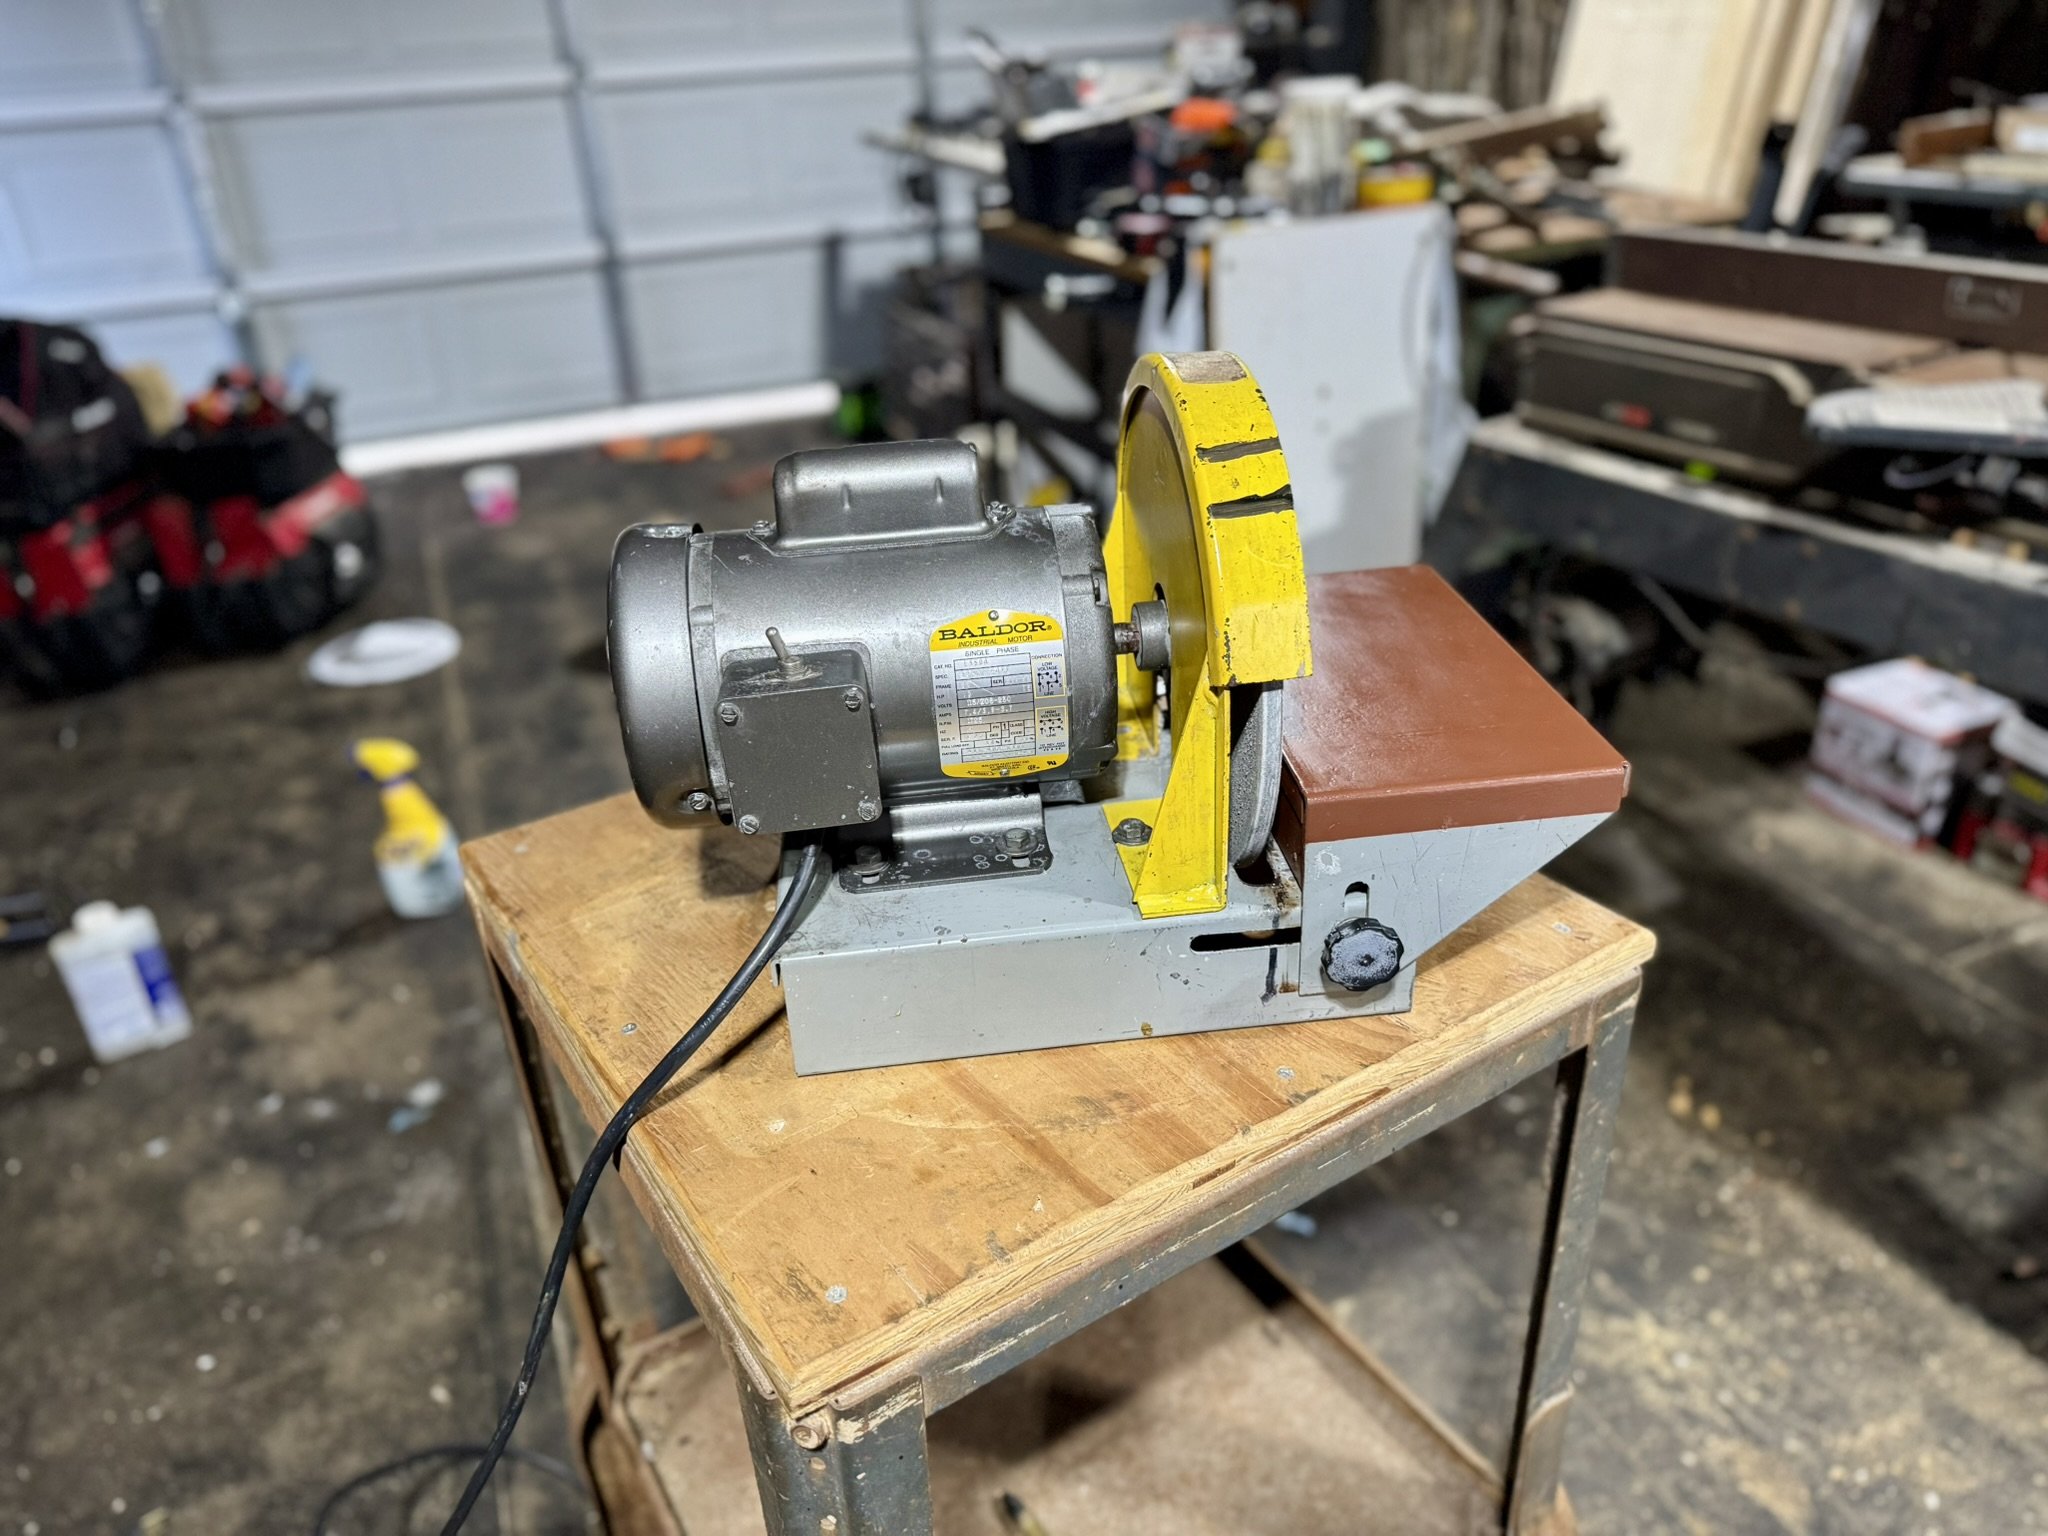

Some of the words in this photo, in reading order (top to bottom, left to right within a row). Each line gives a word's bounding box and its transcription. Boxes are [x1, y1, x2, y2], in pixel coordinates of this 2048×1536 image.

[938, 620, 1047, 641] BALDOR
[957, 638, 999, 648] INDUSTRIAL
[1007, 634, 1033, 643] MOTOR
[964, 648, 990, 658] SINGLE
[996, 646, 1019, 654] PHASE
